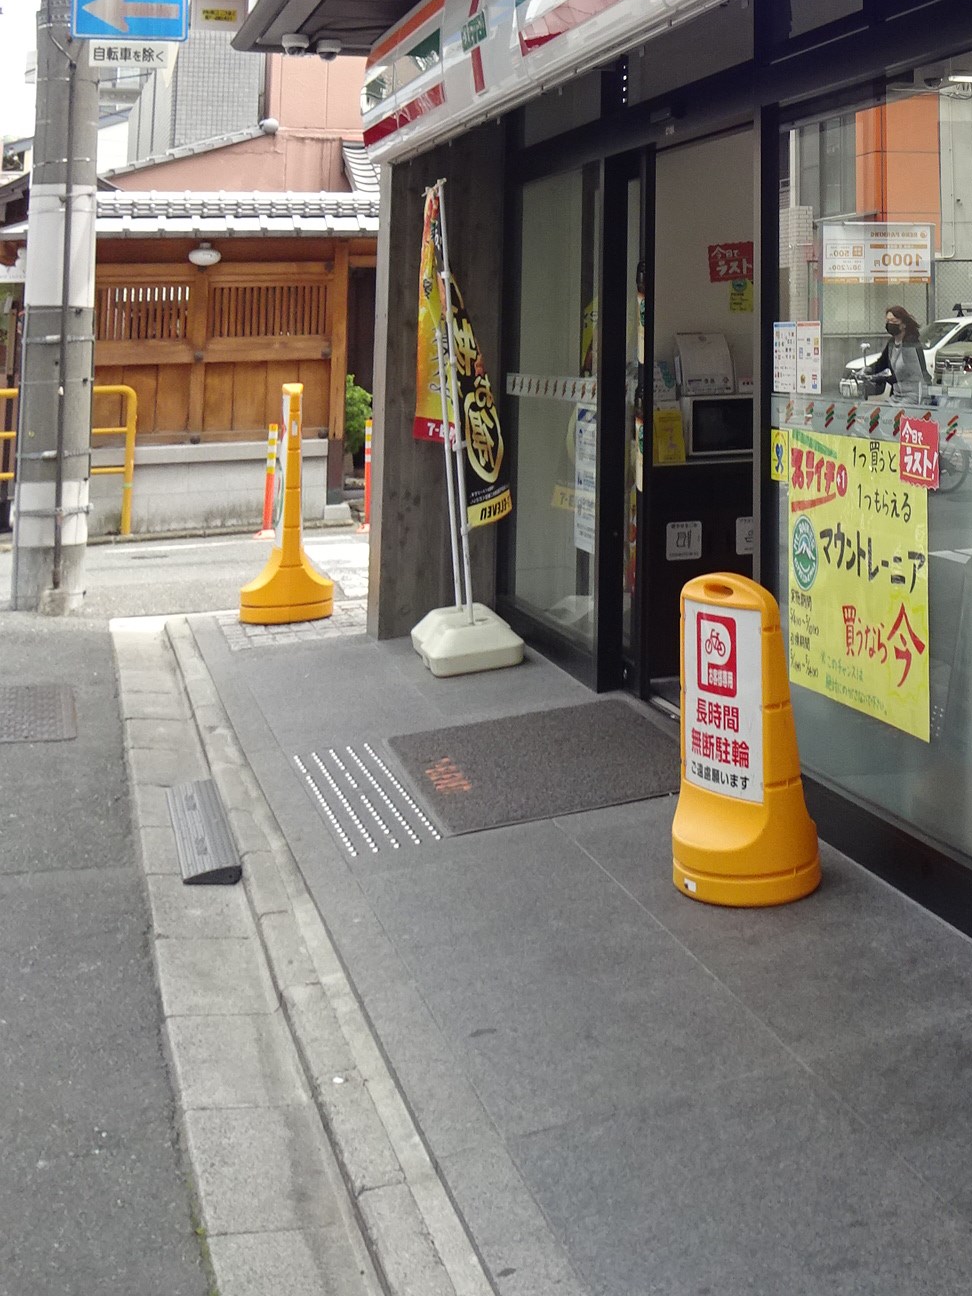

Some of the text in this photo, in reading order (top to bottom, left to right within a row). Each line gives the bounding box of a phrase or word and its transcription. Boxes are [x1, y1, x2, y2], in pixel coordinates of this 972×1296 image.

[93, 46, 164, 63] 自転車を除く
[902, 421, 923, 445] 今日で
[852, 442, 897, 473] 1つ買うと
[858, 484, 912, 523] 1つもらえる
[819, 522, 926, 593] マウントレーニア
[696, 697, 740, 733] 長時間
[691, 728, 750, 769] 無断駐輪
[690, 760, 750, 791] ご遠慮願います
